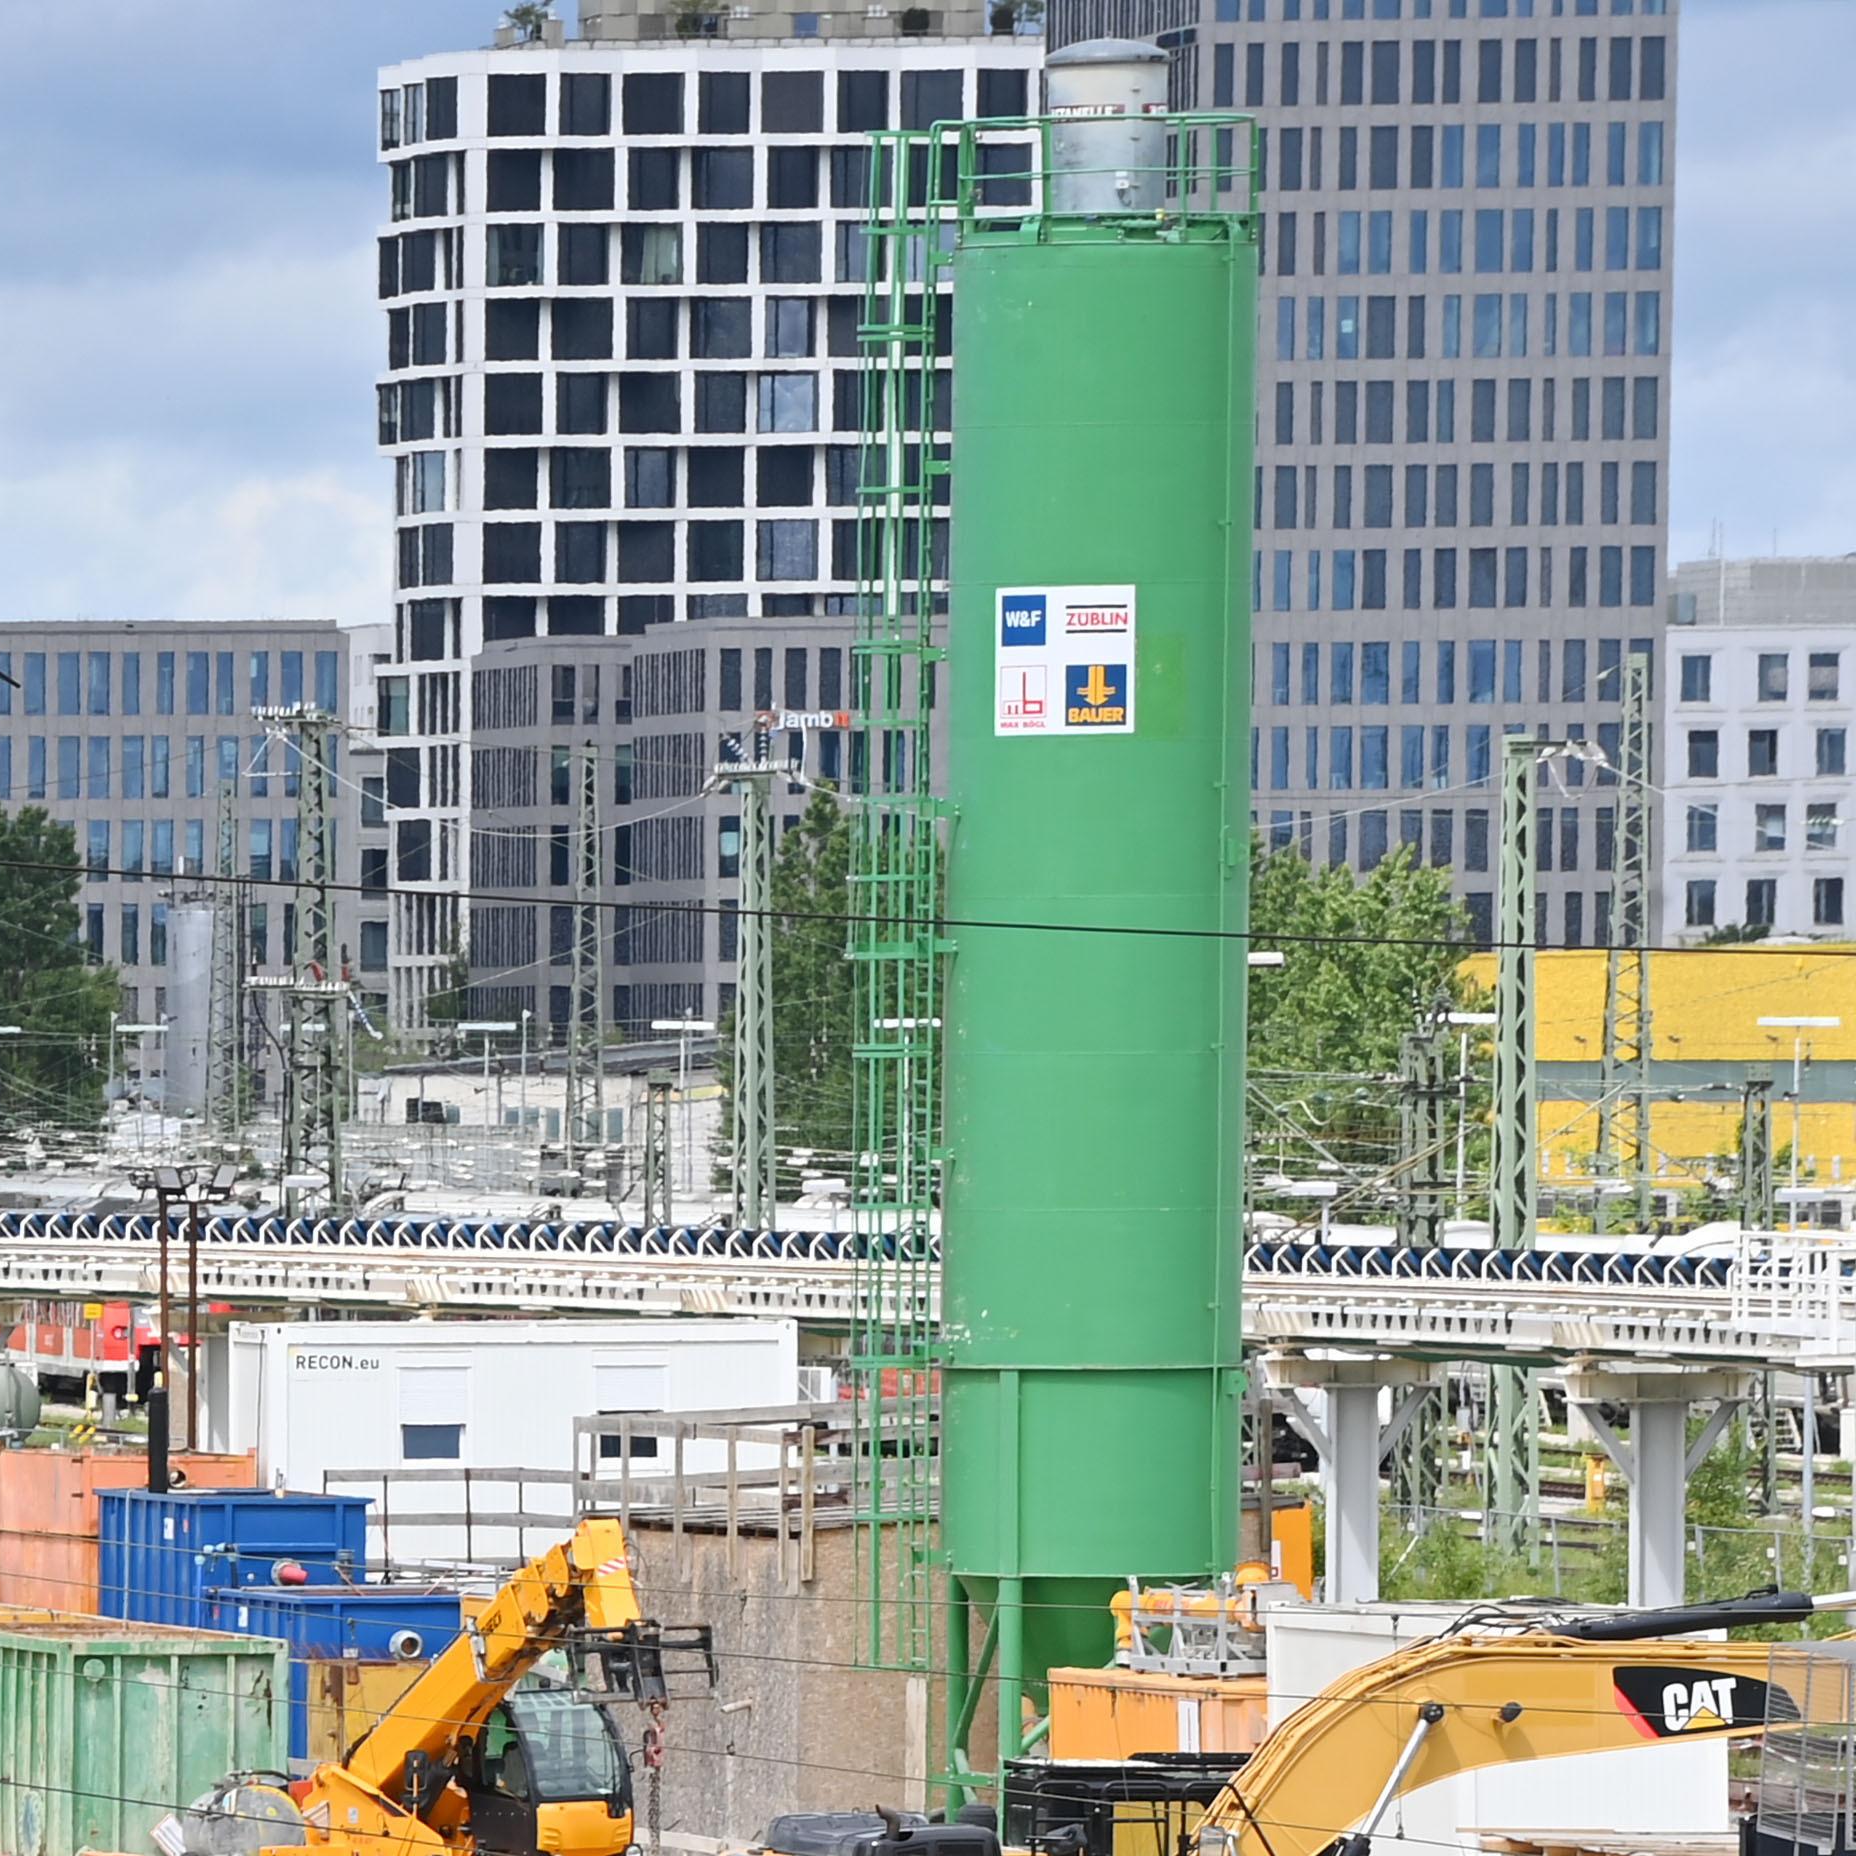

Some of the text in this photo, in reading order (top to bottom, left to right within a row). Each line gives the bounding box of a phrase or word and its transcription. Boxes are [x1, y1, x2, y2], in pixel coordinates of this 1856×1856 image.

[1005, 610, 1042, 628] W&F
[1065, 612, 1128, 627] ZÜBLIN
[1068, 707, 1125, 723] BAUER
[1000, 721, 1019, 729] MAX
[295, 1354, 380, 1370] RECON.eu
[1662, 1677, 1737, 1732] CAT
